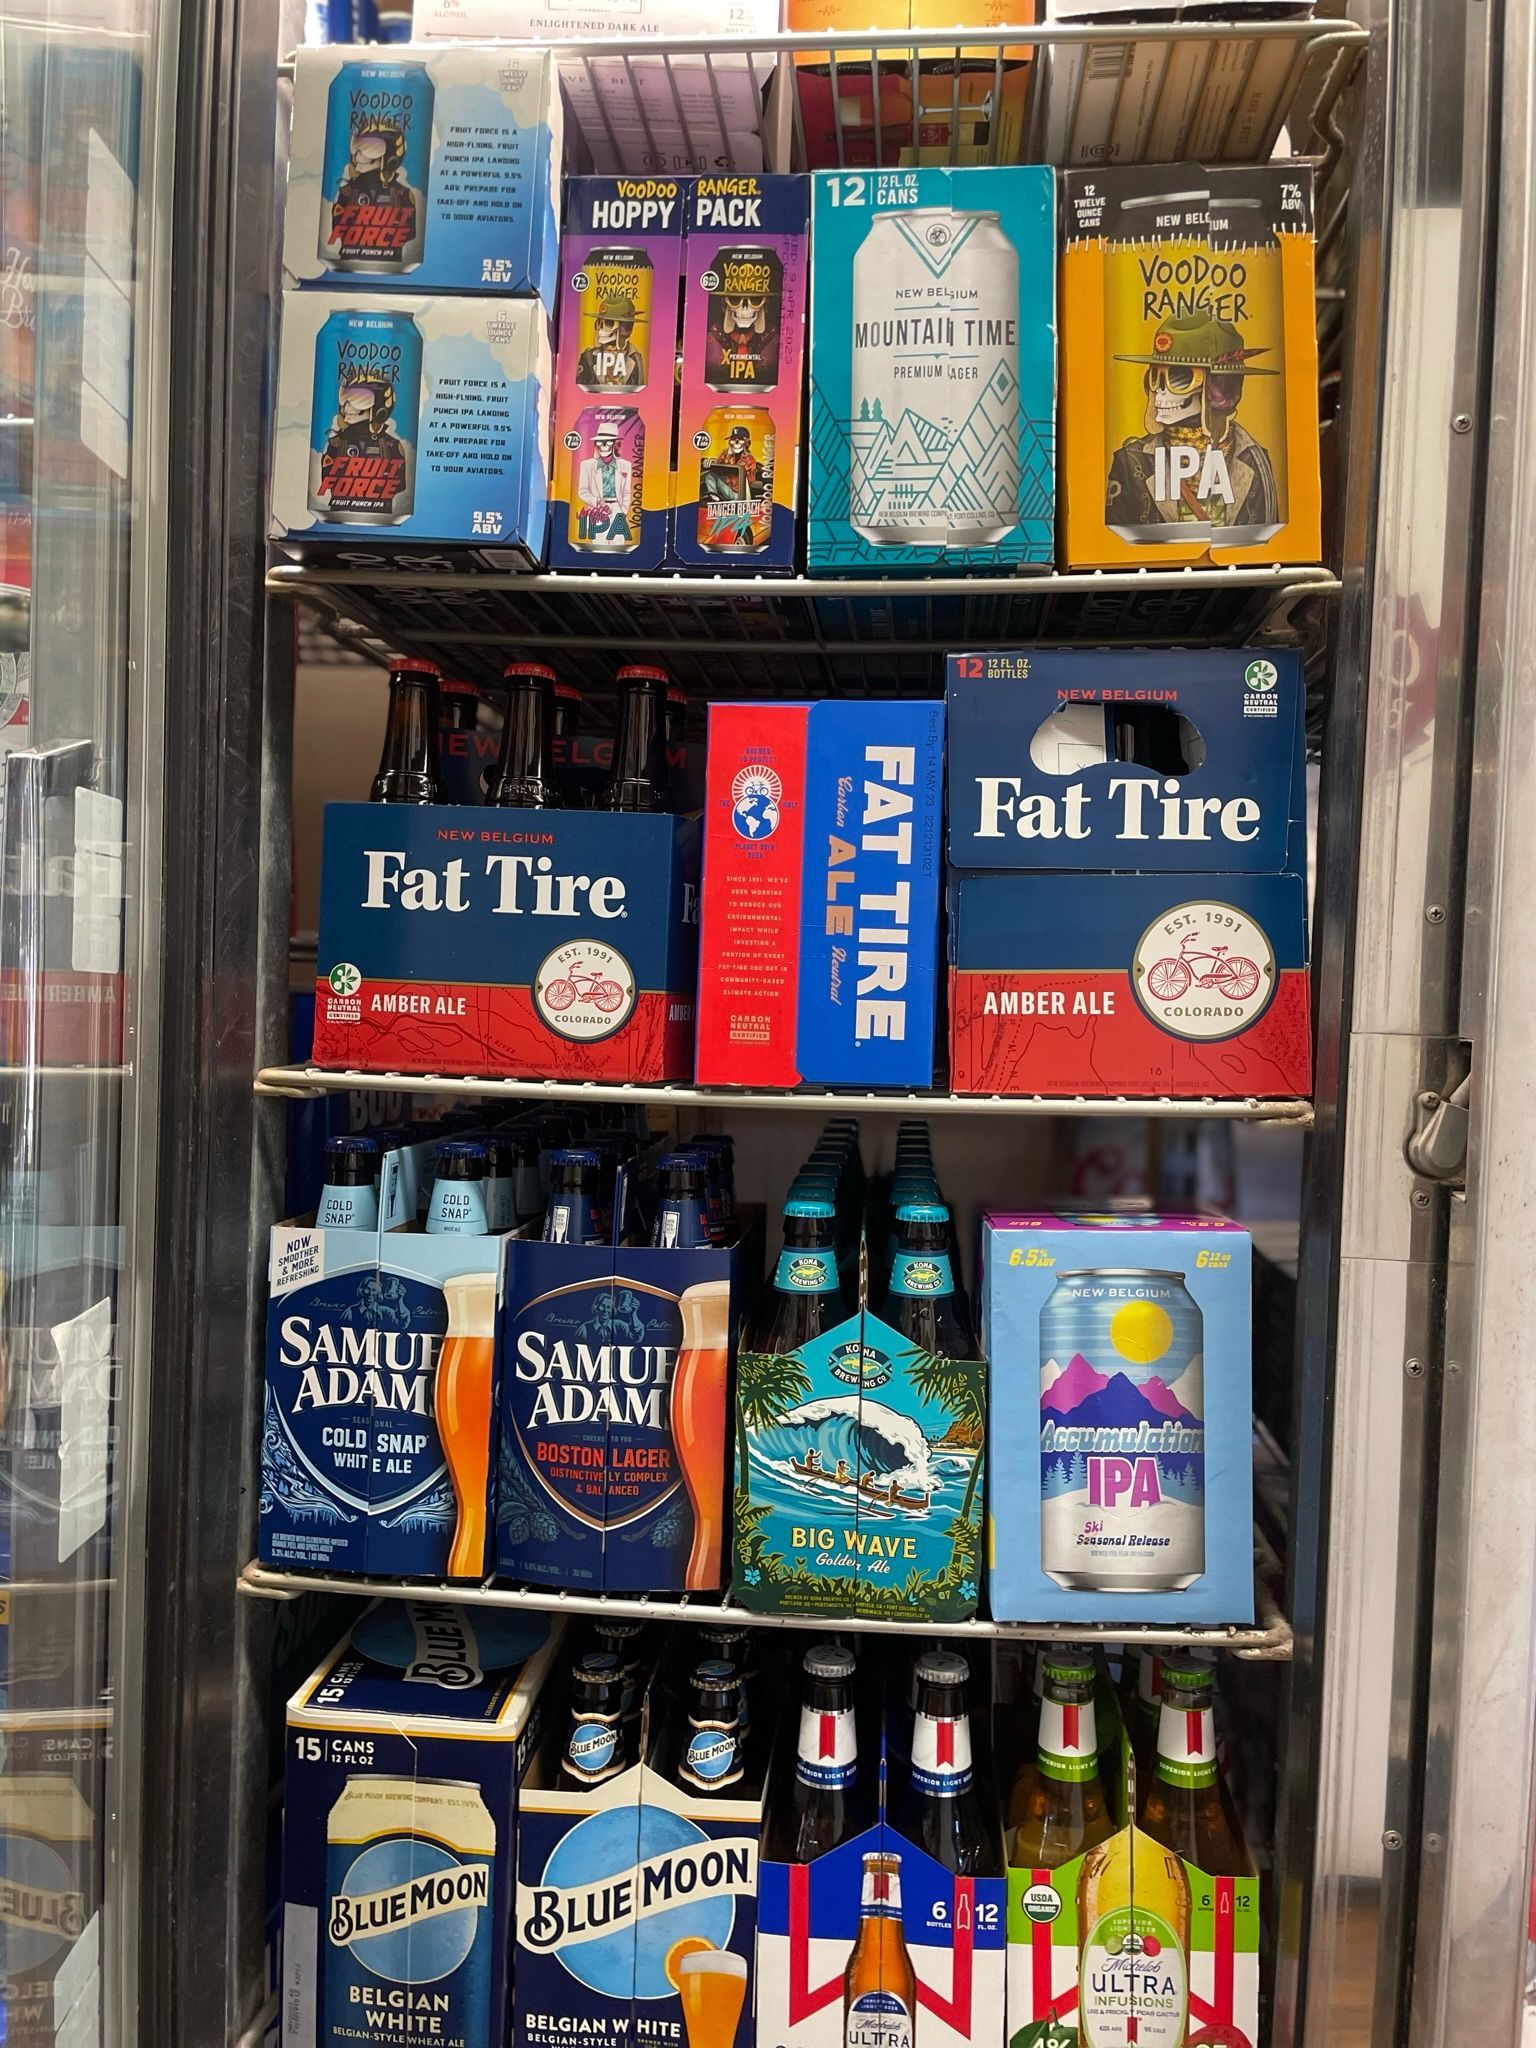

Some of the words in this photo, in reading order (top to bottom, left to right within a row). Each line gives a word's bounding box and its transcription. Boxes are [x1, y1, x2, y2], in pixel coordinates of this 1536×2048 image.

[529, 18, 605, 30] ENLIGHTENED
[607, 21, 636, 31] DARK
[639, 23, 660, 32] ALE
[617, 180, 677, 199] VOODOO
[697, 178, 759, 197] RANGER
[878, 176, 887, 187] 12
[890, 175, 904, 187] FL.
[905, 174, 919, 186] OZ.
[827, 177, 865, 207] 12
[877, 189, 918, 205] CANS
[1084, 185, 1095, 196] 12
[1280, 184, 1301, 199] 7%
[1074, 197, 1106, 208] TWELVE
[1281, 198, 1301, 211] ABV
[592, 200, 675, 229] HOPPY
[696, 198, 761, 227] PACK
[1077, 208, 1102, 218] OUNCE
[1156, 215, 1180, 227] NEW
[1079, 218, 1100, 228] CANS
[596, 272, 639, 286] VOODOO
[723, 263, 771, 278] VOODOO
[1139, 255, 1246, 288] VOODOO
[595, 285, 639, 300] RANGER
[724, 277, 770, 293] RANGER
[1144, 285, 1249, 323] RANGER
[349, 320, 365, 328] NEW
[366, 320, 393, 329] BELGIUM
[964, 319, 1016, 346] TIME
[337, 341, 402, 360] VOODOO
[721, 349, 762, 365] XPERIMENTAL
[337, 361, 402, 383] RANGER
[596, 352, 627, 376] IPA
[730, 360, 755, 380] IPA
[894, 365, 942, 379] PREMIUM
[439, 378, 463, 387] FRUIT
[464, 378, 488, 388] FORCE
[490, 380, 498, 388] IS
[499, 380, 506, 388] A
[486, 395, 509, 404] FRUIT
[433, 407, 459, 415] PUNCH
[461, 408, 475, 416] IPA
[476, 409, 510, 418] LANDING
[429, 421, 439, 429] AT
[441, 421, 447, 430] A
[450, 422, 491, 431] POWERFUL
[493, 424, 512, 433] 9.5%
[453, 437, 489, 446] PREPARE
[426, 450, 461, 459] TAKE-OFF
[462, 452, 478, 460] AND
[480, 453, 501, 461] HOLD
[329, 457, 404, 478] FRUIT
[431, 465, 441, 473] TO
[443, 465, 464, 474] YOUR
[1155, 444, 1235, 504] IPA
[317, 476, 400, 499] FORCE
[473, 511, 502, 524] 9.5%
[707, 502, 737, 517] DANGER
[737, 501, 761, 516] BEACH
[472, 523, 502, 535] ABV
[957, 658, 983, 678] 12
[1057, 689, 1096, 701] NEW
[1102, 690, 1178, 701] BELGIUM
[836, 776, 853, 828] Carbon
[862, 745, 916, 865] FAT
[973, 777, 1092, 840] Fat
[1108, 778, 1261, 842] Tire
[438, 829, 475, 841] NEW
[481, 831, 554, 844] BELGIUM
[361, 850, 471, 913] Fat
[486, 855, 627, 918] Tire
[826, 835, 856, 936] ALE
[1163, 911, 1197, 937] EST.
[1205, 911, 1244, 934] 1991
[855, 881, 910, 1041] TIRE
[830, 945, 847, 1006] Neutral
[371, 993, 430, 1015] AMBER
[435, 996, 466, 1016] ALE
[983, 991, 1066, 1015] AMBER
[1072, 991, 1116, 1015] ALE
[1163, 1005, 1244, 1017] COLORADO
[730, 1014, 771, 1023] CARBON
[730, 1022, 771, 1031] NEUTRAL
[327, 1199, 353, 1211] COLD
[325, 1212, 352, 1224] SNAP
[286, 1235, 311, 1254] NOW
[278, 1245, 319, 1267] SMOOTHER
[282, 1265, 289, 1275] &
[291, 1256, 314, 1273] MORE
[276, 1265, 320, 1287] REFRESHING
[1072, 1288, 1105, 1298] NEW
[1109, 1288, 1170, 1298] BELGIUM
[280, 1316, 445, 1371] SAMUE
[845, 1344, 876, 1359] KONA
[515, 1331, 679, 1384] SAMUE
[291, 1367, 434, 1416] ADAM
[526, 1382, 668, 1429] ADAM
[322, 1427, 367, 1449] COLD
[377, 1434, 427, 1455] SNAP
[1040, 1419, 1204, 1453] Accumulation
[333, 1452, 380, 1473] WHITE
[386, 1461, 412, 1474] ALE
[536, 1442, 604, 1464] BOSTON
[612, 1449, 671, 1468] LAGER
[550, 1467, 621, 1482] DISTINCTIVELY
[624, 1472, 668, 1483] COMPLEX
[1087, 1456, 1162, 1508] IPA
[576, 1484, 582, 1494] &
[586, 1484, 639, 1496] BALANCED
[1084, 1520, 1104, 1533] Ski
[792, 1527, 834, 1550] BIG
[844, 1531, 918, 1559] WAVE
[1076, 1534, 1126, 1546] Seasonal
[1128, 1535, 1170, 1547] Release
[816, 1553, 860, 1571] Golden
[867, 1559, 890, 1573] Ale
[295, 1736, 322, 1761] 15
[332, 1740, 375, 1753] CANS
[570, 1741, 591, 1755] BLUE
[592, 1731, 618, 1750] MOON
[1159, 1762, 1191, 1776] SUPERIOR
[331, 1893, 407, 1941] BLUE
[410, 1872, 487, 1915] MOON
[524, 1879, 632, 1947] BLUE
[643, 1848, 751, 1907] MOON
[1031, 1893, 1053, 1903] USDA
[932, 1901, 946, 1920] 6
[975, 1904, 998, 1922] 12
[1028, 1904, 1056, 1913] ORGANIC
[1101, 1958, 1161, 1972] Michelob
[1092, 1973, 1176, 1995] ULTRA
[350, 1986, 449, 2012] BELGIAN
[1094, 1995, 1174, 2008] INFUSIONS
[366, 2010, 442, 2034] WHITE
[526, 2014, 606, 2033] BELGIAN
[612, 2019, 681, 2038] WHITE
[333, 2026, 405, 2044] BELGIAN-STYLE
[408, 2036, 446, 2047] WHEAT
[448, 2039, 465, 2048] ALE
[527, 2033, 617, 2047] BELGIAN-STYLE
